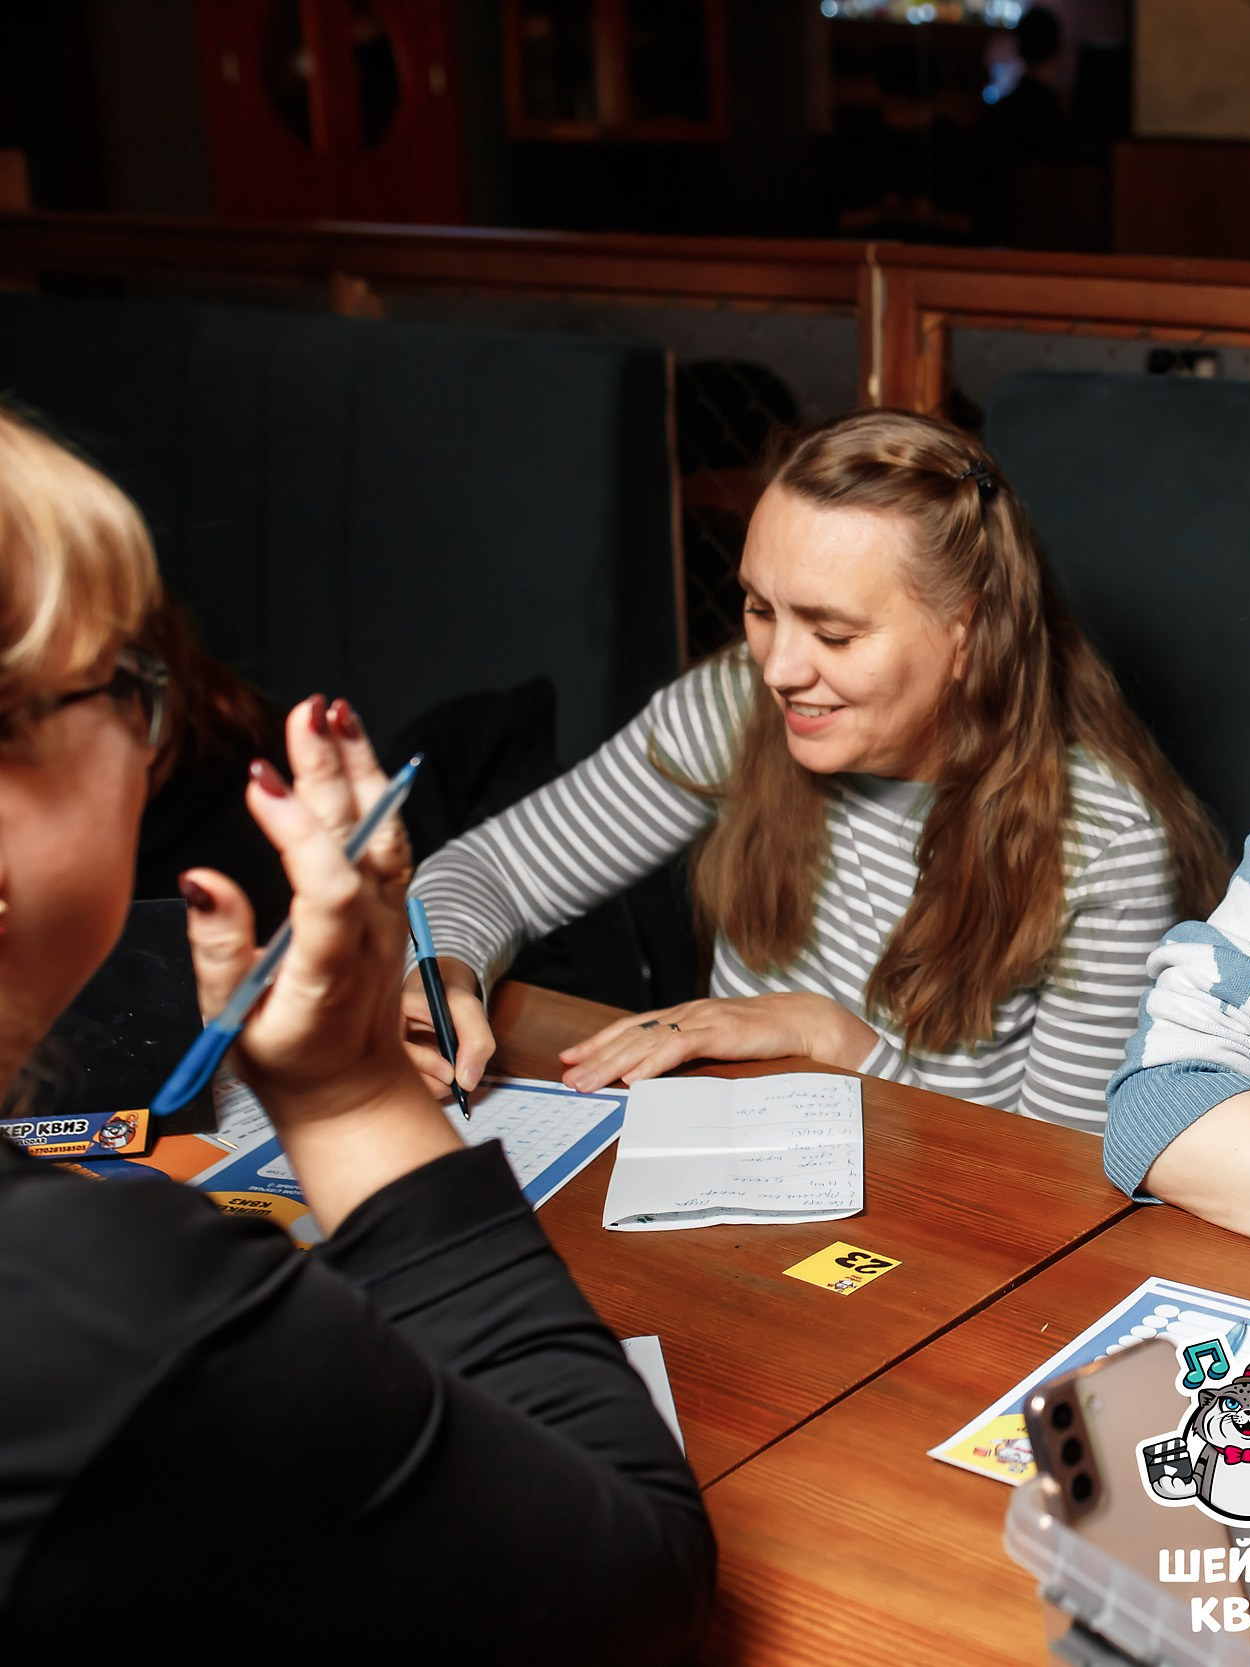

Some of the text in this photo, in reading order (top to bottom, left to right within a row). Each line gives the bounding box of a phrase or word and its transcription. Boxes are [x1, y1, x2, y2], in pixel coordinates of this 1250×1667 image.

[37, 1119, 89, 1137] КВИЗ
[229, 1199, 272, 1208] КВИЗ
[834, 1252, 894, 1275] 23
